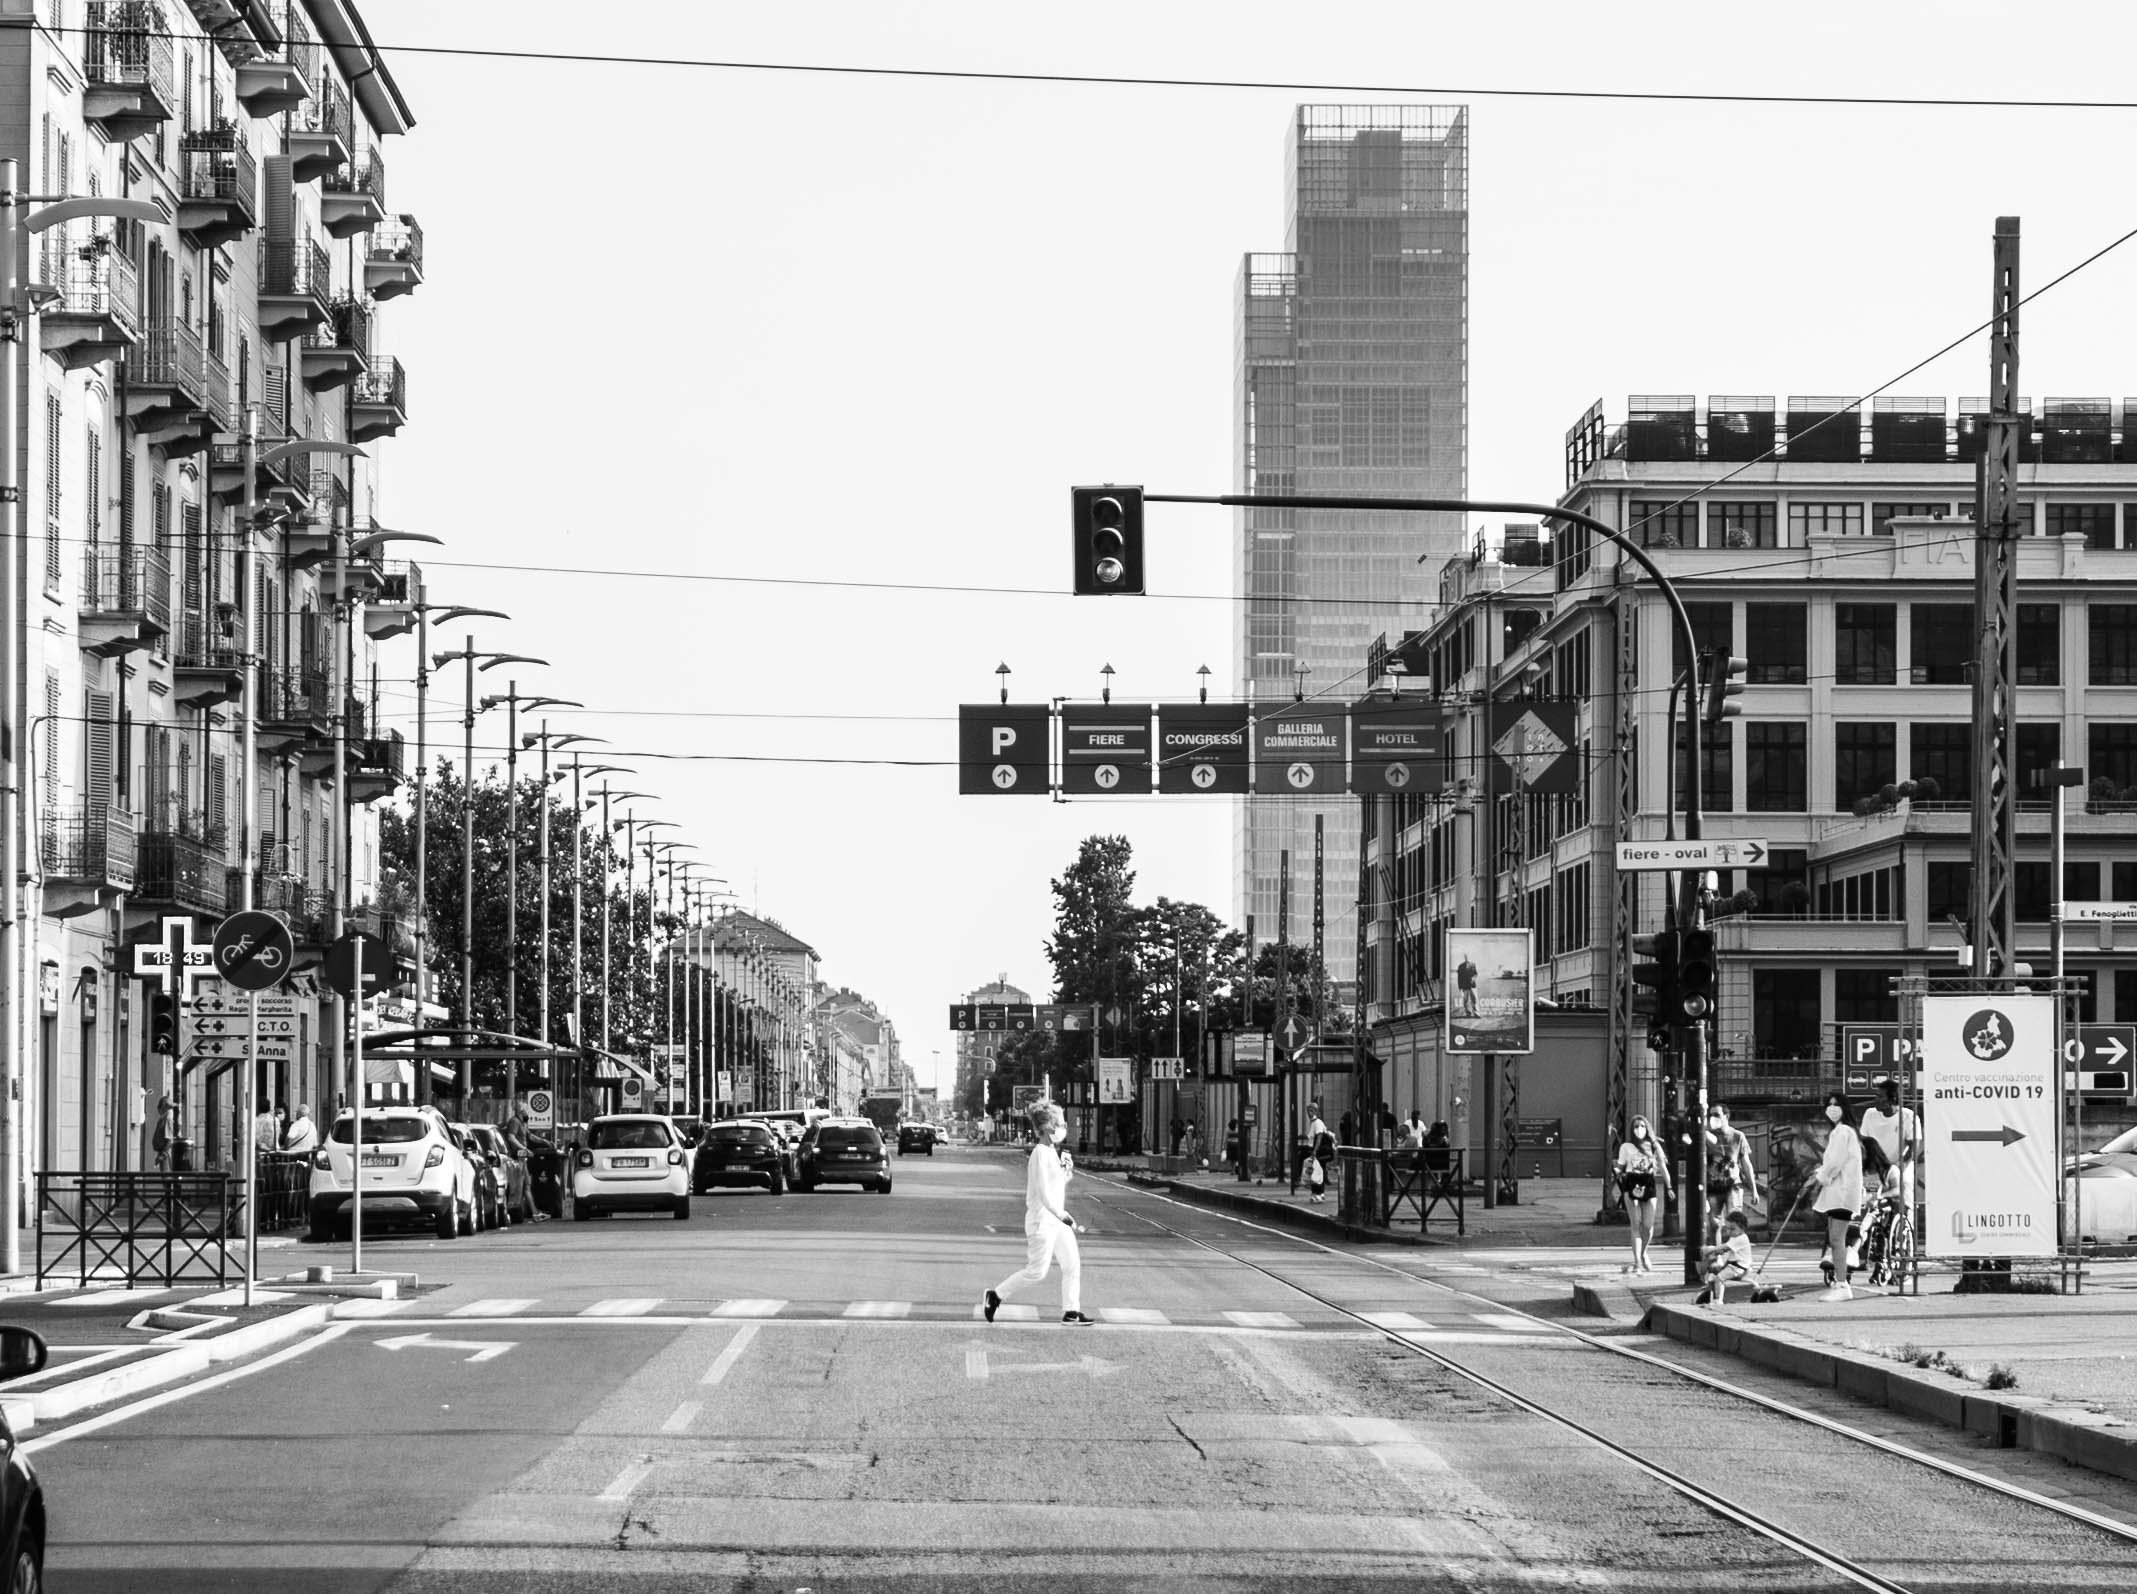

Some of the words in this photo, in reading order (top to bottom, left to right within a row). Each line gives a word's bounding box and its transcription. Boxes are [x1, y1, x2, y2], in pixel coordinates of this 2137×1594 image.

[1901, 529, 1976, 564] FIA
[1277, 723, 1324, 735] GALLERIA
[992, 726, 1017, 756] P
[1088, 734, 1125, 745] FIERE
[1165, 734, 1243, 746] CONGRESSI
[1264, 735, 1337, 747] COMMERCIALE
[1375, 734, 1418, 744] HOTEL
[1622, 848, 1660, 860] fiere
[1675, 847, 1708, 859] oval
[229, 1005, 249, 1013] Regin
[257, 1047, 286, 1056] Anna
[1857, 1038, 1875, 1062] P
[1934, 1072, 1970, 1082] Centro
[1974, 1072, 2044, 1082] vaccinazione
[1934, 1086, 2020, 1099] anti-COVID
[2026, 1086, 2044, 1099] 19
[1968, 1214, 2031, 1228] LINGOTTO
